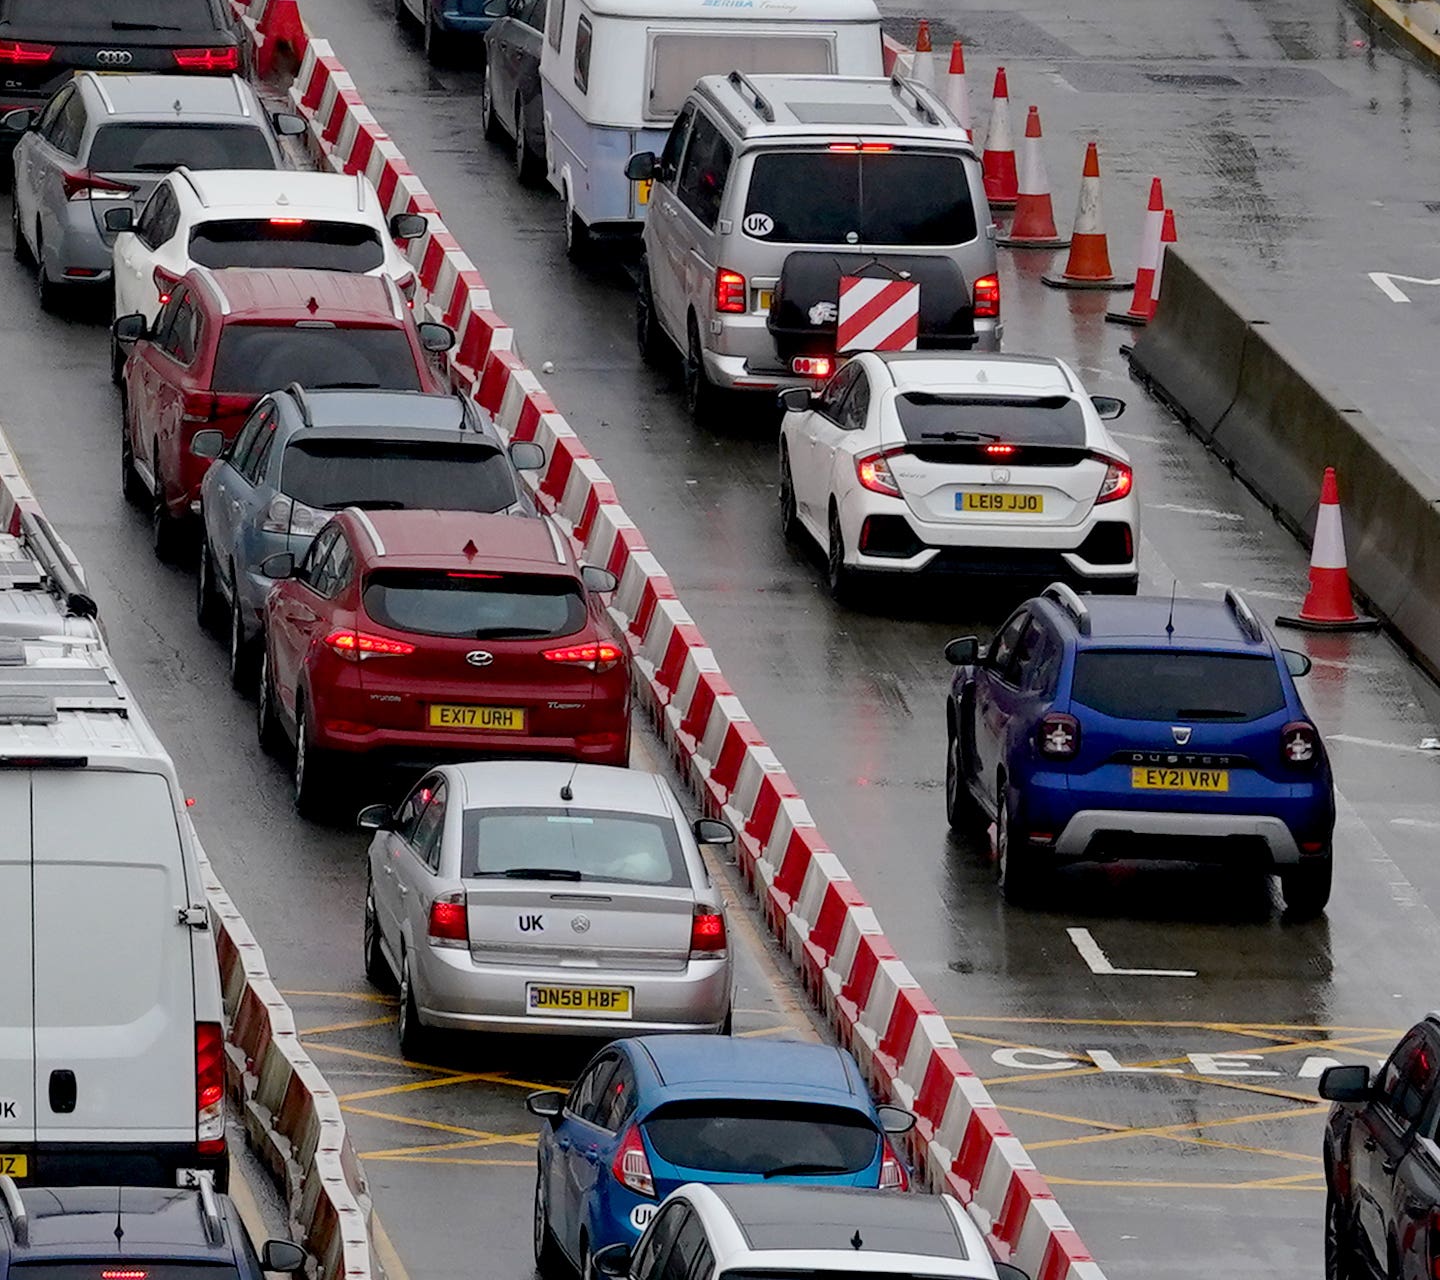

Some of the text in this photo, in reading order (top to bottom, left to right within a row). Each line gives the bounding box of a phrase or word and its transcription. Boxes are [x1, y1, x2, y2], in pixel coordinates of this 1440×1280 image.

[748, 218, 768, 231] UK
[969, 494, 1004, 510] LE19
[439, 708, 514, 726] EX17 URH
[1132, 753, 1230, 764] DUSTER
[1146, 770, 1222, 788] EY21 VRV
[519, 915, 544, 931] UK
